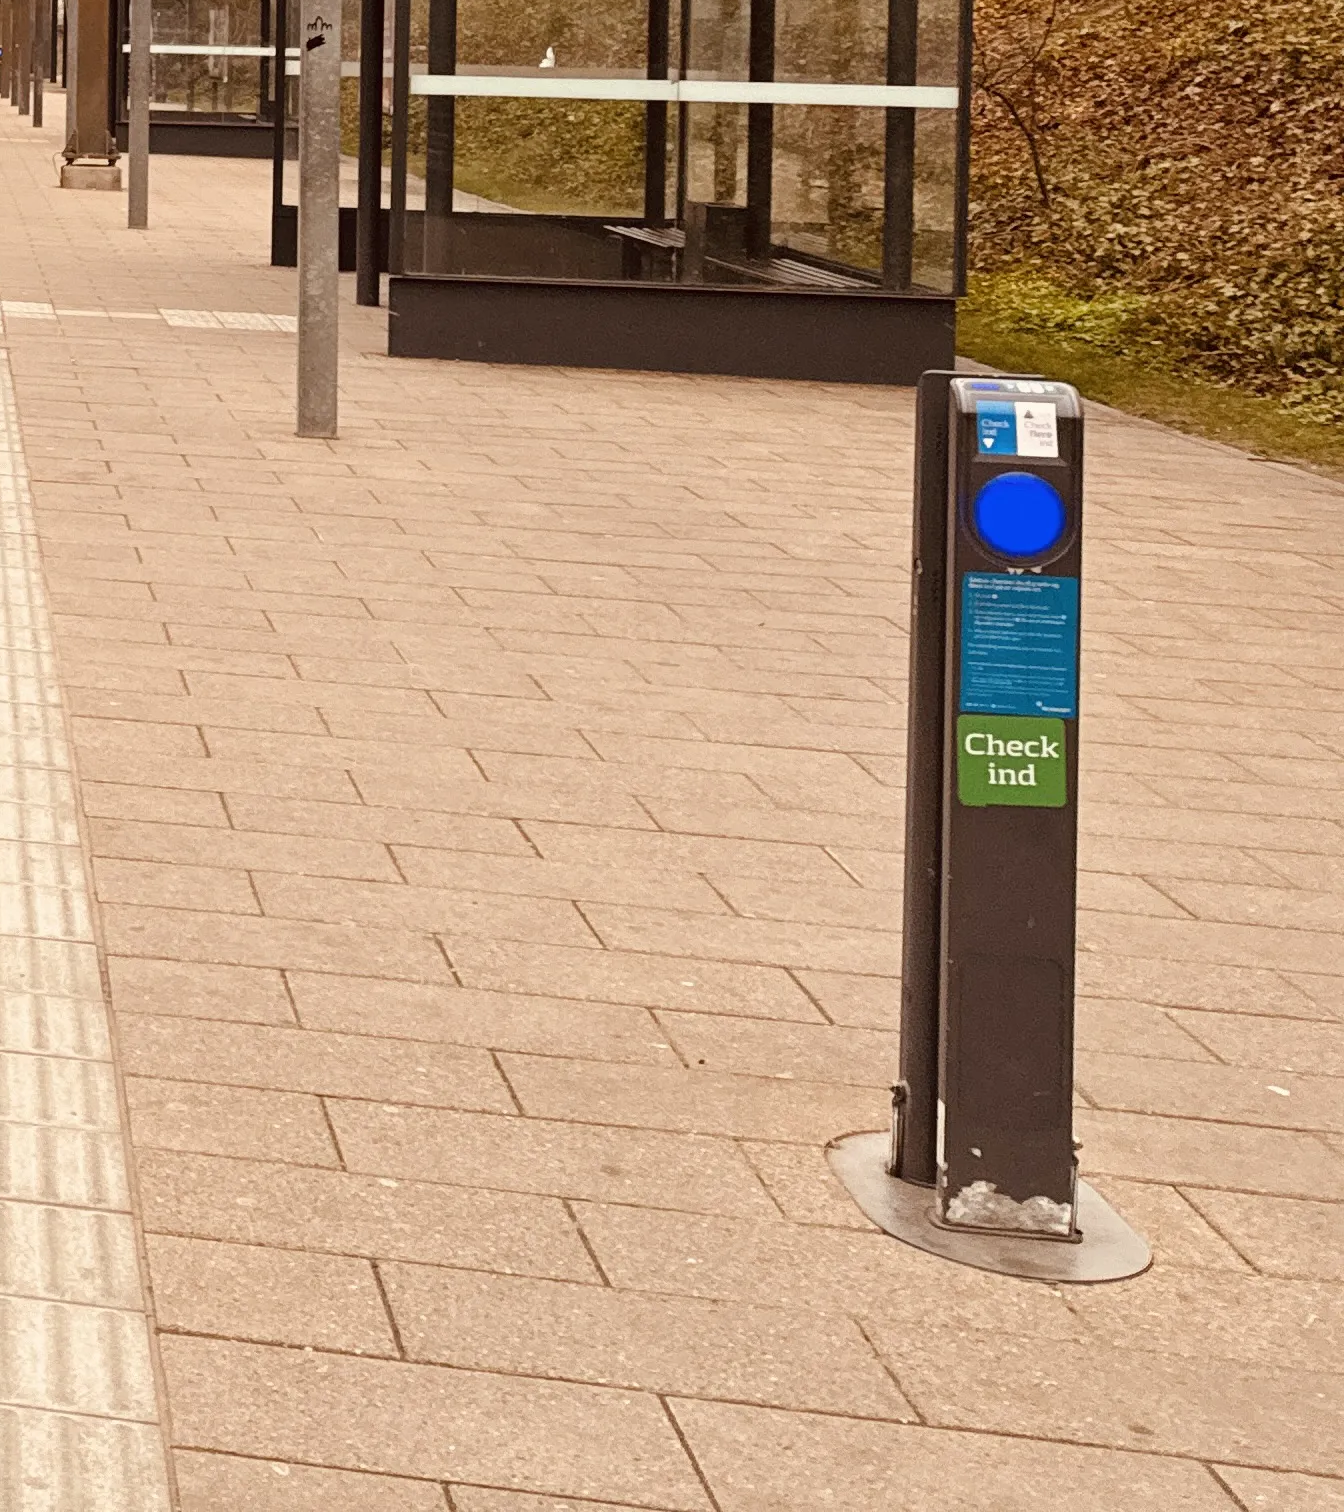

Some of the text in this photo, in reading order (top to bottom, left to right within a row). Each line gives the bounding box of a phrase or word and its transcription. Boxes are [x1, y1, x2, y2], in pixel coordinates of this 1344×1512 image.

[981, 418, 1010, 429] Check
[964, 732, 1060, 759] Check
[987, 761, 1037, 787] ind
